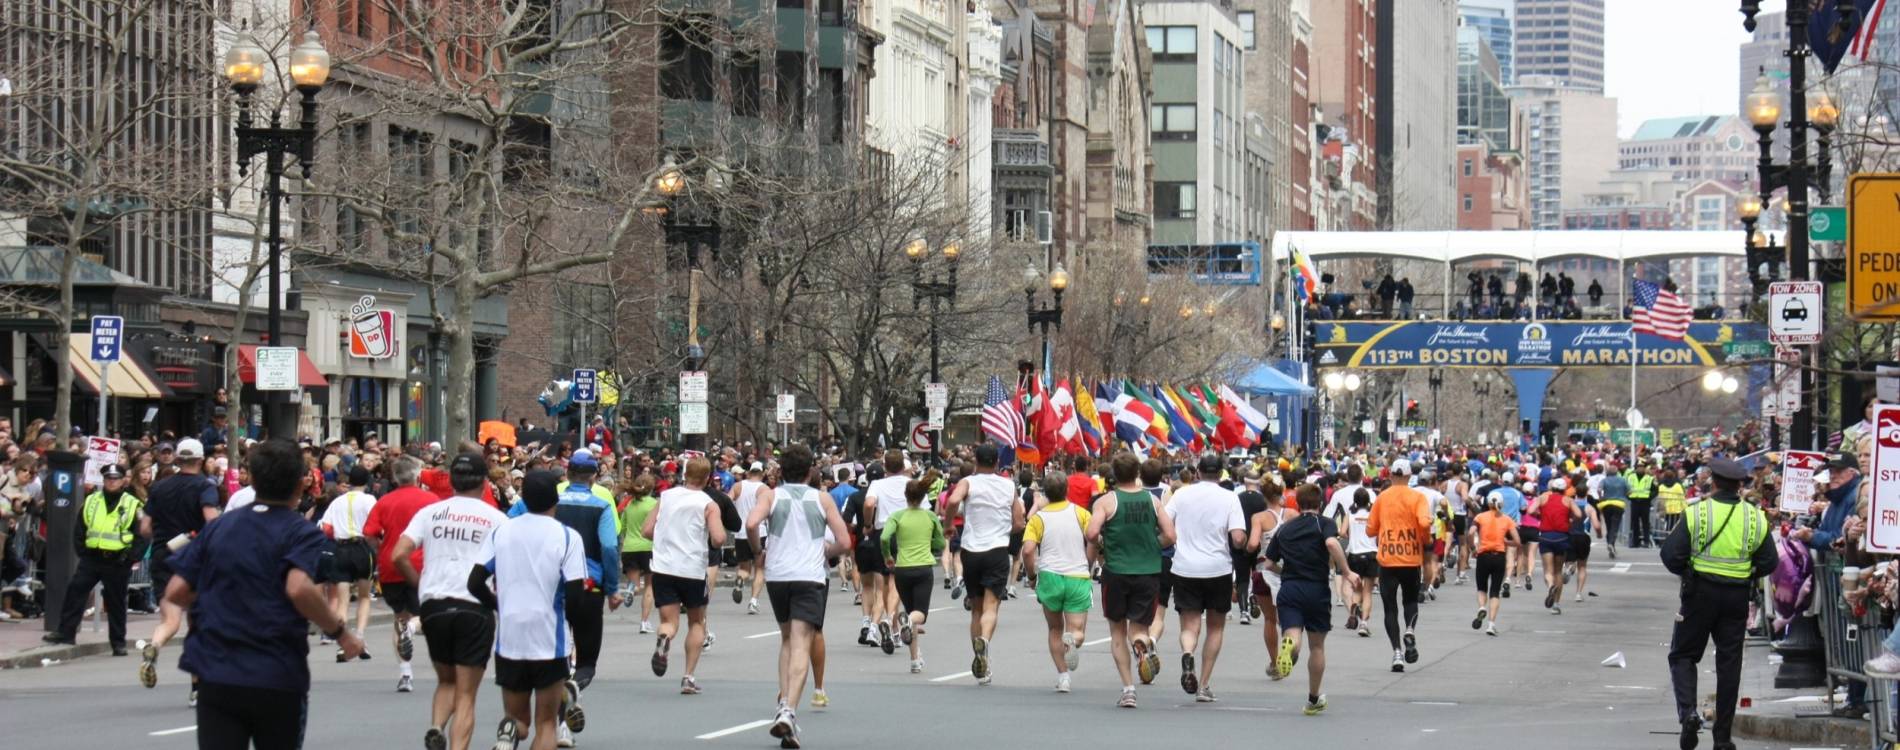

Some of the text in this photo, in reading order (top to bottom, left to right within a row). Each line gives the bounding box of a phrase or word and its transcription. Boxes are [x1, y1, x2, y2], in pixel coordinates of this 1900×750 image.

[1773, 284, 1818, 294] TOW ZONE
[1872, 282, 1898, 303] ON
[101, 319, 114, 328] PAY
[95, 327, 118, 336] METER
[367, 333, 380, 343] DD
[1792, 334, 1816, 342] STAND
[97, 336, 115, 345] HERE
[1368, 349, 1508, 364] 113TH BOSTON
[1562, 349, 1692, 364] MARATHON
[57, 473, 70, 490] P
[1881, 469, 1900, 482] ST
[1122, 501, 1150, 513] TEAM
[1882, 509, 1899, 526] FRI
[432, 525, 483, 544] CHILE
[1747, 510, 1756, 551] POLICE
[1381, 543, 1421, 557] POOCH
